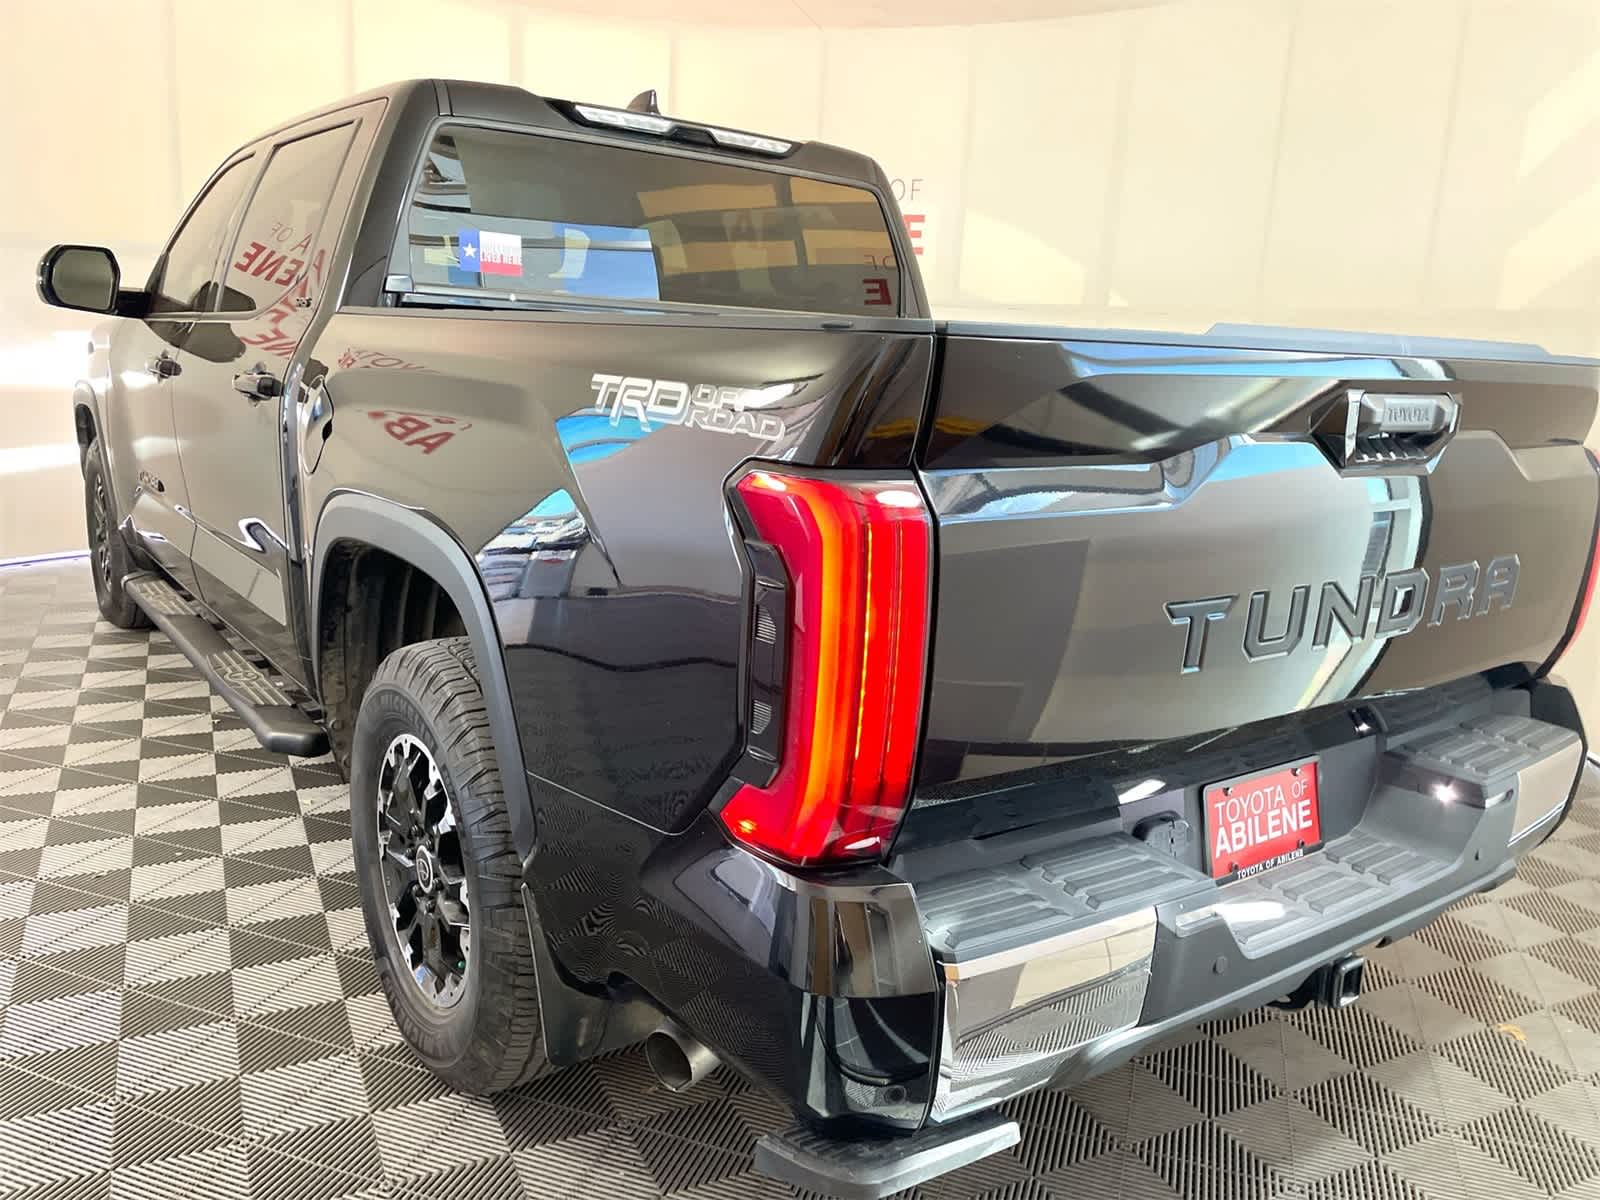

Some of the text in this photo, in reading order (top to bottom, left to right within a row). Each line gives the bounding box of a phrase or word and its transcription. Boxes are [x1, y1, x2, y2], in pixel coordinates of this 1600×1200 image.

[591, 373, 693, 433] TRD
[684, 407, 786, 441] ROAD
[1385, 406, 1432, 423] TOYOTA
[1162, 553, 1521, 674] TUNDRA
[1214, 778, 1308, 826] TOYOTA OF
[1215, 799, 1313, 859] ABILENE
[1236, 848, 1304, 879] TOYOTA OF ABILENE
